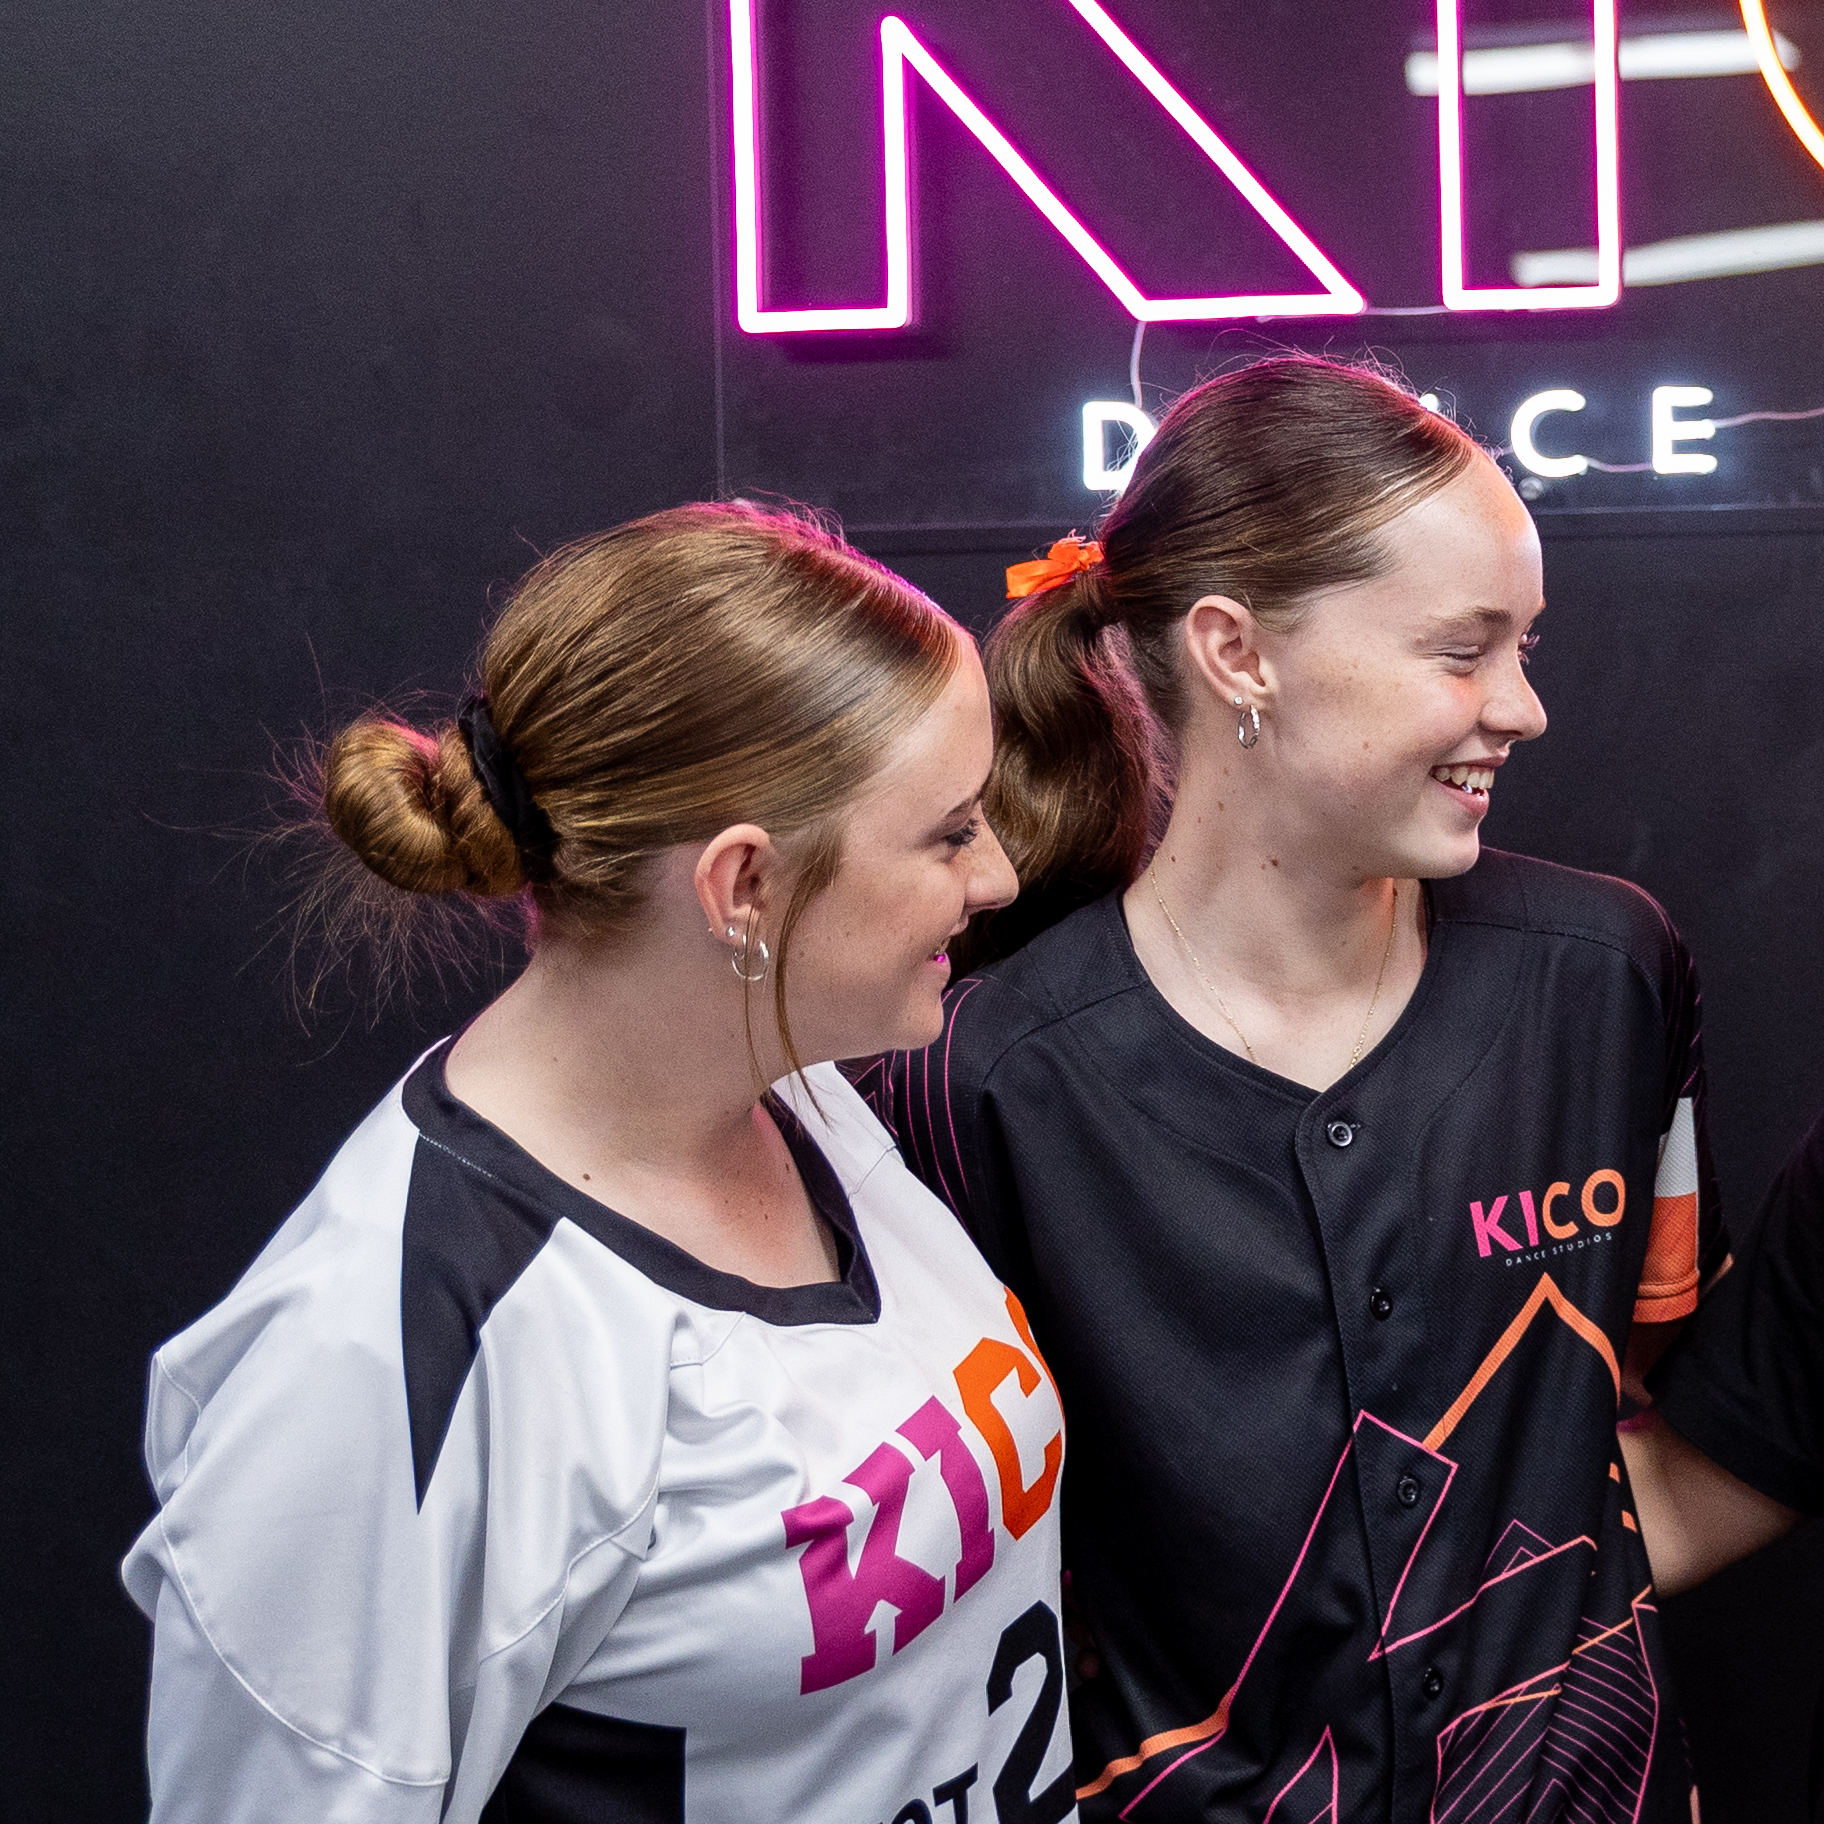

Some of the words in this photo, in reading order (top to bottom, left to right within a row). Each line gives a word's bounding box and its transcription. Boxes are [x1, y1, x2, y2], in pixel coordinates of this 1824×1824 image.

[1082, 385, 1718, 492] DCE
[1469, 1168, 1627, 1258] KICO
[1505, 1249, 1546, 1267] DANCE
[1552, 1231, 1612, 1255] STUDIOS
[782, 1285, 1066, 1696] KIC
